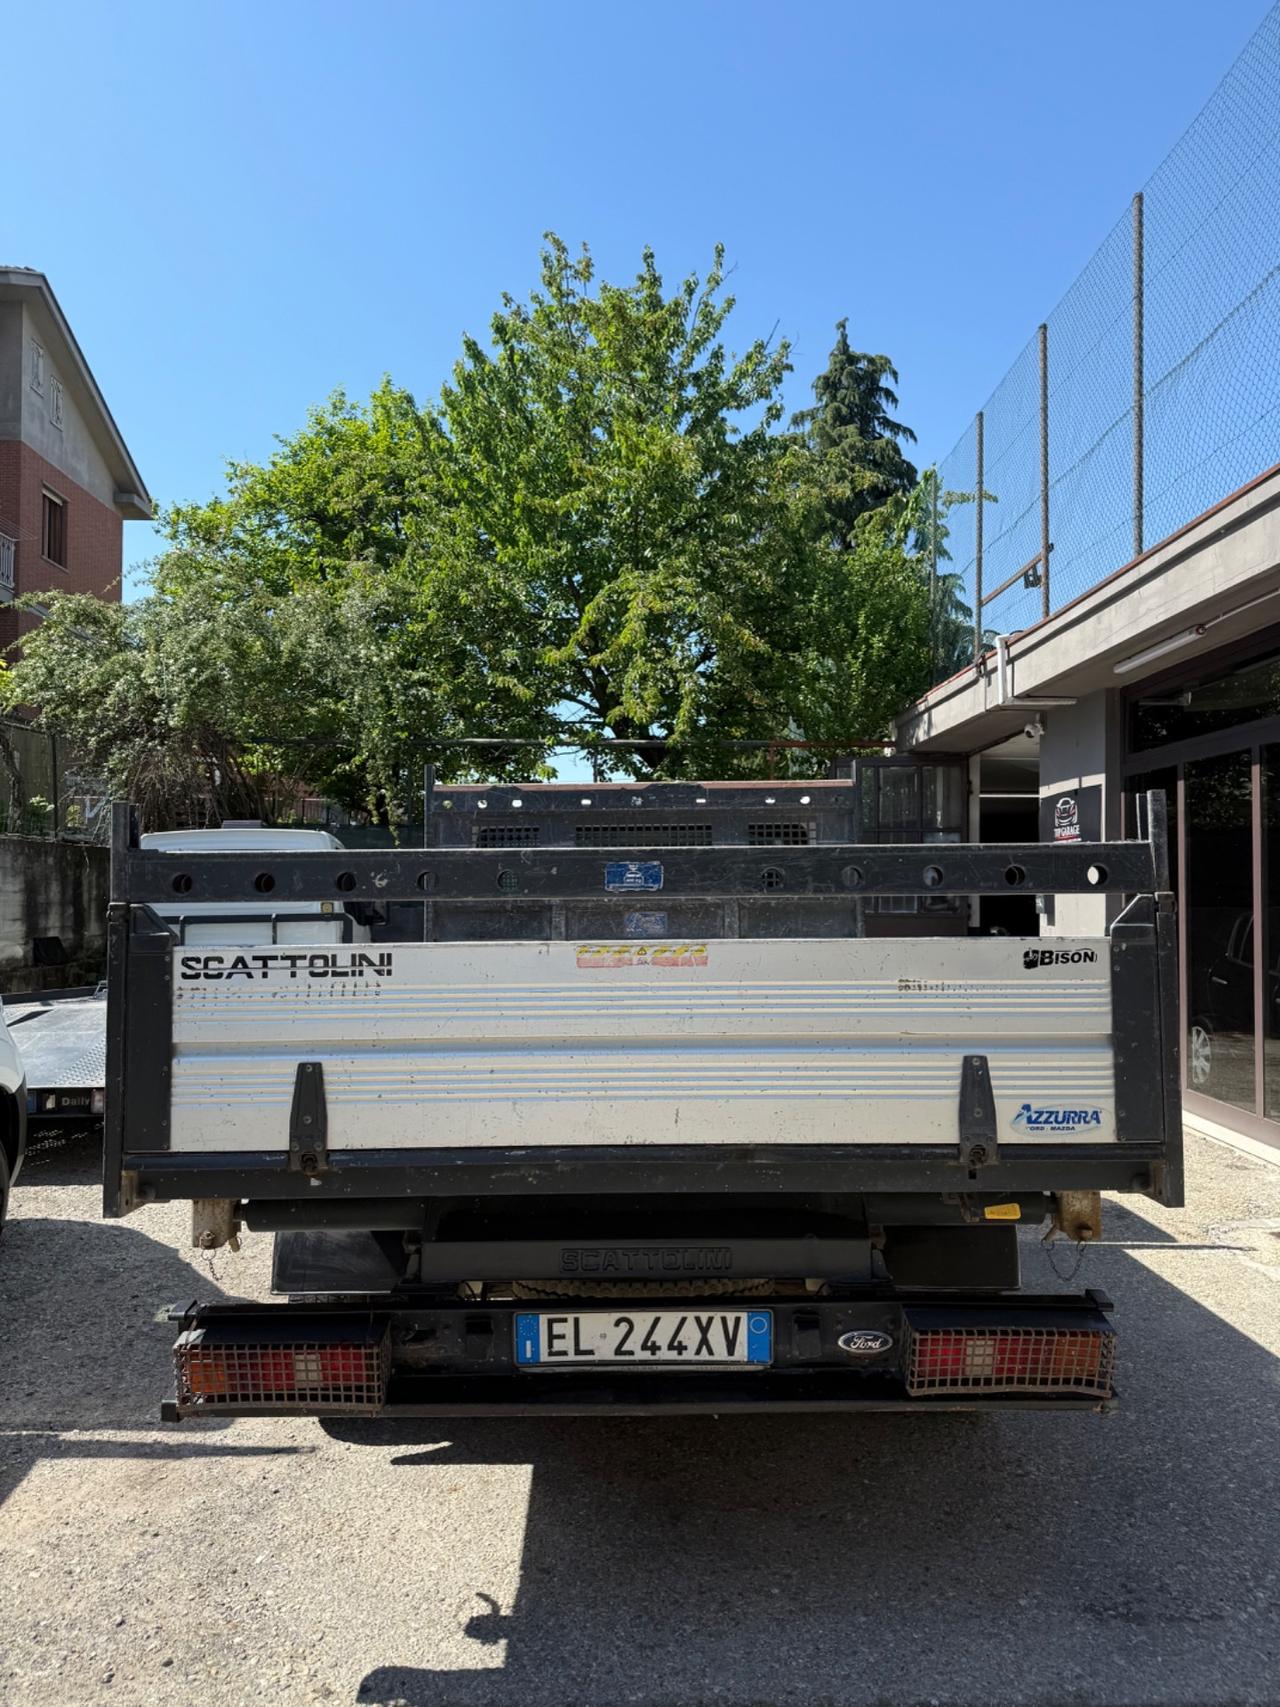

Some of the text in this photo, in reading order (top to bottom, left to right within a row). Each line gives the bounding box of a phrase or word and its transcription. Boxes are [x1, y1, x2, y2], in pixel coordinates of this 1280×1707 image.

[181, 953, 393, 979] SCATTOLINI
[1040, 950, 1095, 966] BISON
[62, 1096, 90, 1107] Daily
[1012, 1104, 1102, 1124] AZZURRA
[561, 1250, 733, 1272] SCATTOLINI
[547, 1317, 595, 1357] EL
[614, 1316, 741, 1356] 244XV
[850, 1335, 884, 1349] Ford
